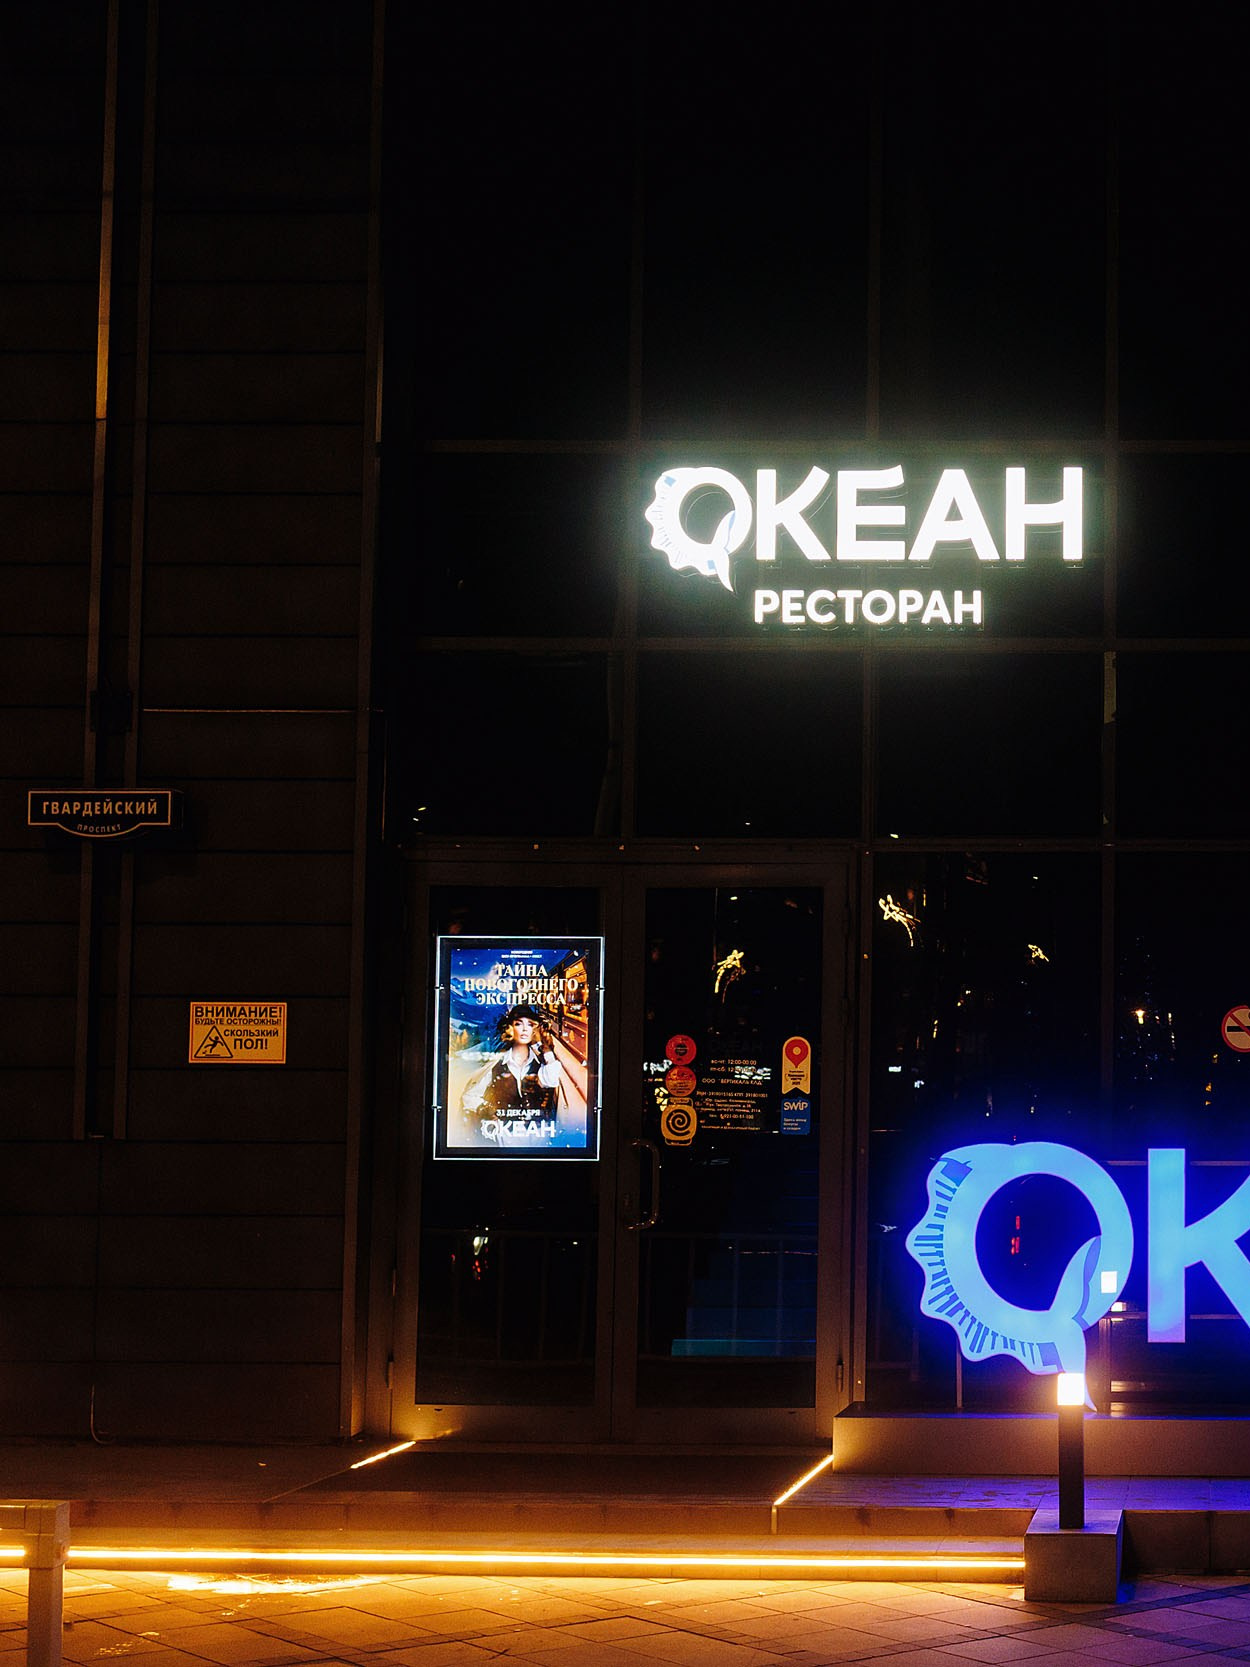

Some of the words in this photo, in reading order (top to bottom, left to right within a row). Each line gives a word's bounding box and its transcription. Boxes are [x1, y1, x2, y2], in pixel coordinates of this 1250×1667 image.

[645, 464, 1084, 592] ОКЕАН
[754, 589, 983, 625] РЕСТОРАН
[42, 798, 157, 817] ГВАРДЕЙСКИЙ
[76, 823, 121, 834] ПРОСПЕКТ
[495, 961, 549, 977] ТАЙНА
[464, 978, 579, 992] НОВОГОДНЕГО
[475, 992, 567, 1006] ЭКСПРЕССА
[194, 1006, 282, 1018] ВНИМАНИЕ!
[195, 1018, 224, 1026] БУДЬТЕ
[223, 1028, 279, 1037] СКОЛЬЗКИЙ
[233, 1038, 268, 1050] ПОЛ!
